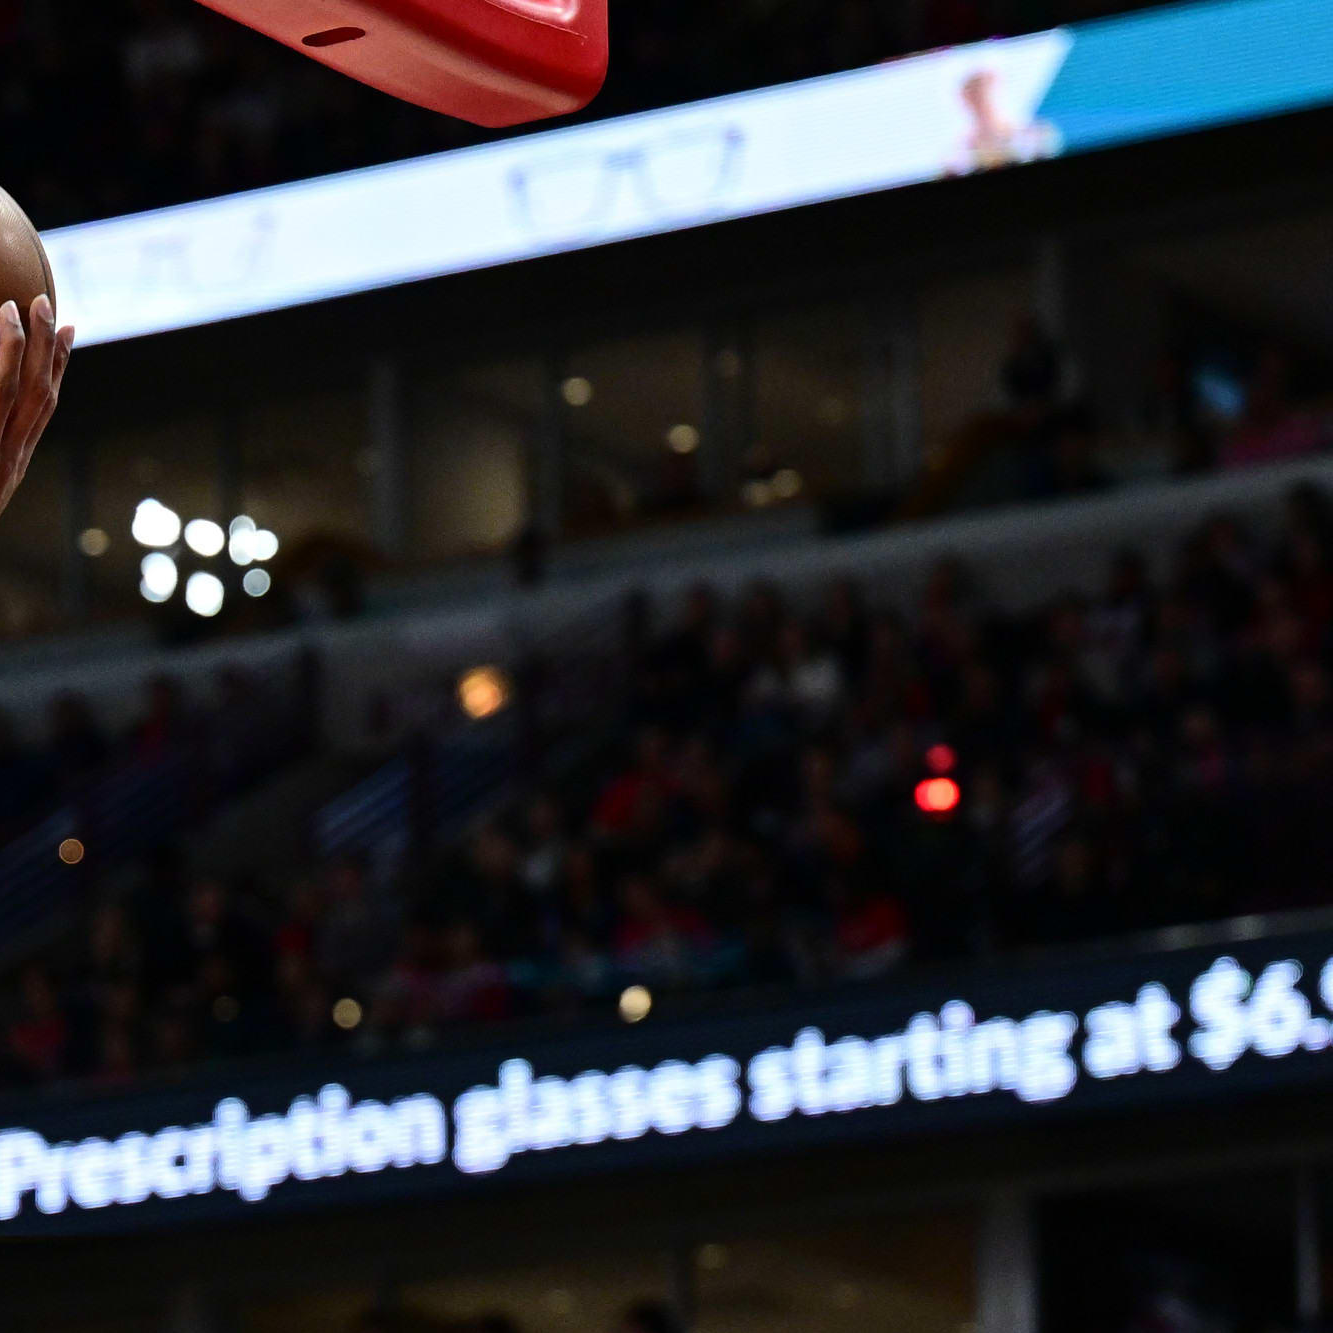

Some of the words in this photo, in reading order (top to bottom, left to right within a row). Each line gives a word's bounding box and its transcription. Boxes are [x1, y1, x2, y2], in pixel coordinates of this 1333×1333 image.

[450, 1055, 742, 1174] glasses
[746, 999, 1078, 1122] starting
[1082, 981, 1181, 1080] at
[1188, 955, 1333, 1071] $6.
